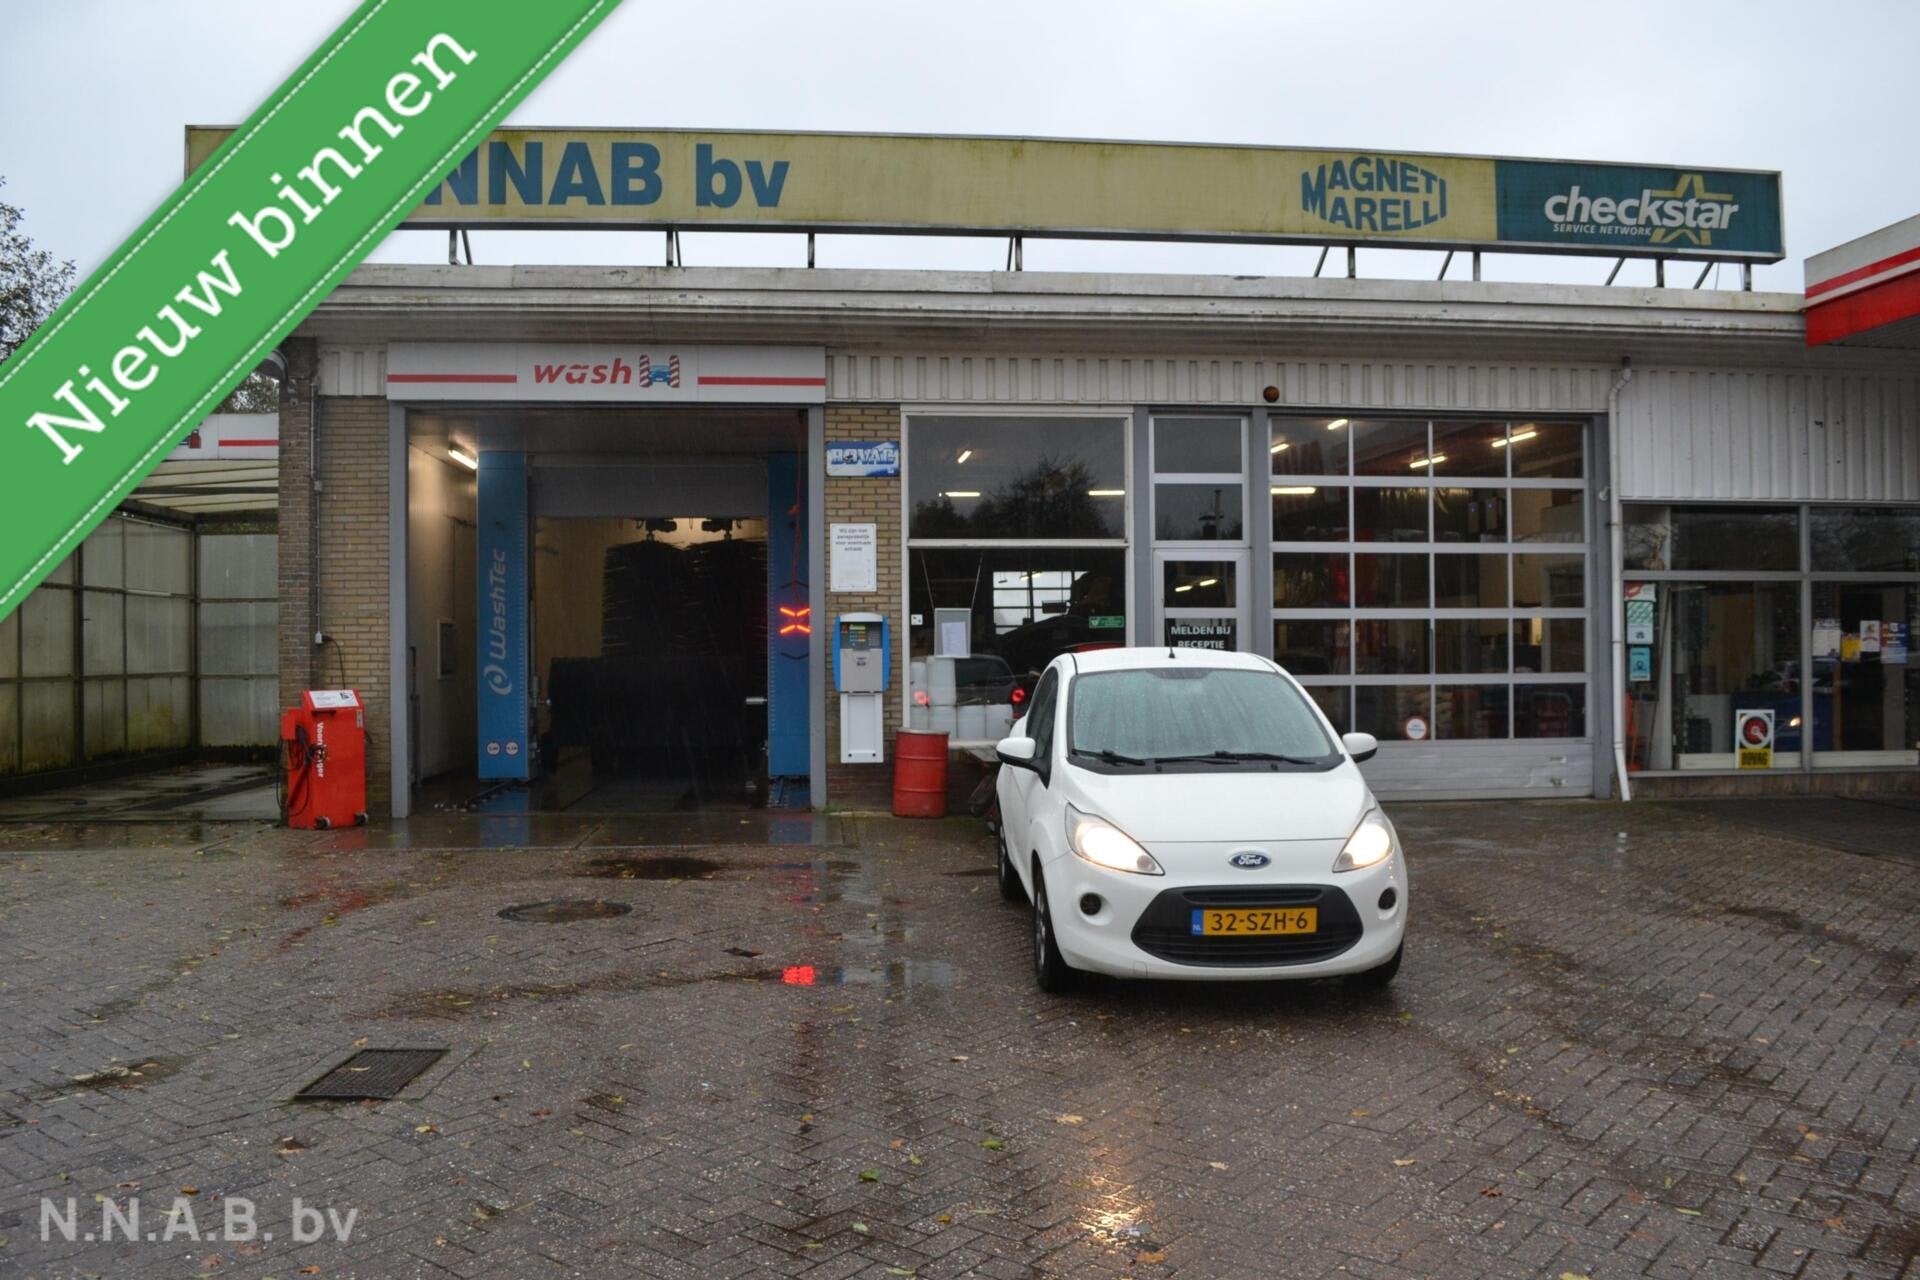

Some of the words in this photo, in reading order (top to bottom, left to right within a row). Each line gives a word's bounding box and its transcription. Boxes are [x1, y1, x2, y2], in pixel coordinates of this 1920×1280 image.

[695, 143, 790, 208] bv
[1302, 156, 1447, 204] MAGNETI
[1302, 191, 1447, 232] MARELLI
[1544, 185, 1739, 229] checkstar
[1553, 223, 1596, 234] SERVICE
[1600, 226, 1651, 236] NETWORK
[534, 357, 632, 384] wash
[489, 549, 507, 660] WashTec
[1171, 626, 1214, 635] MELDEN
[1216, 627, 1231, 635] BIJ
[1178, 640, 1225, 649] RECEPTIE
[1238, 853, 1262, 866] Ford
[1211, 912, 1308, 931] 32-SZH-6
